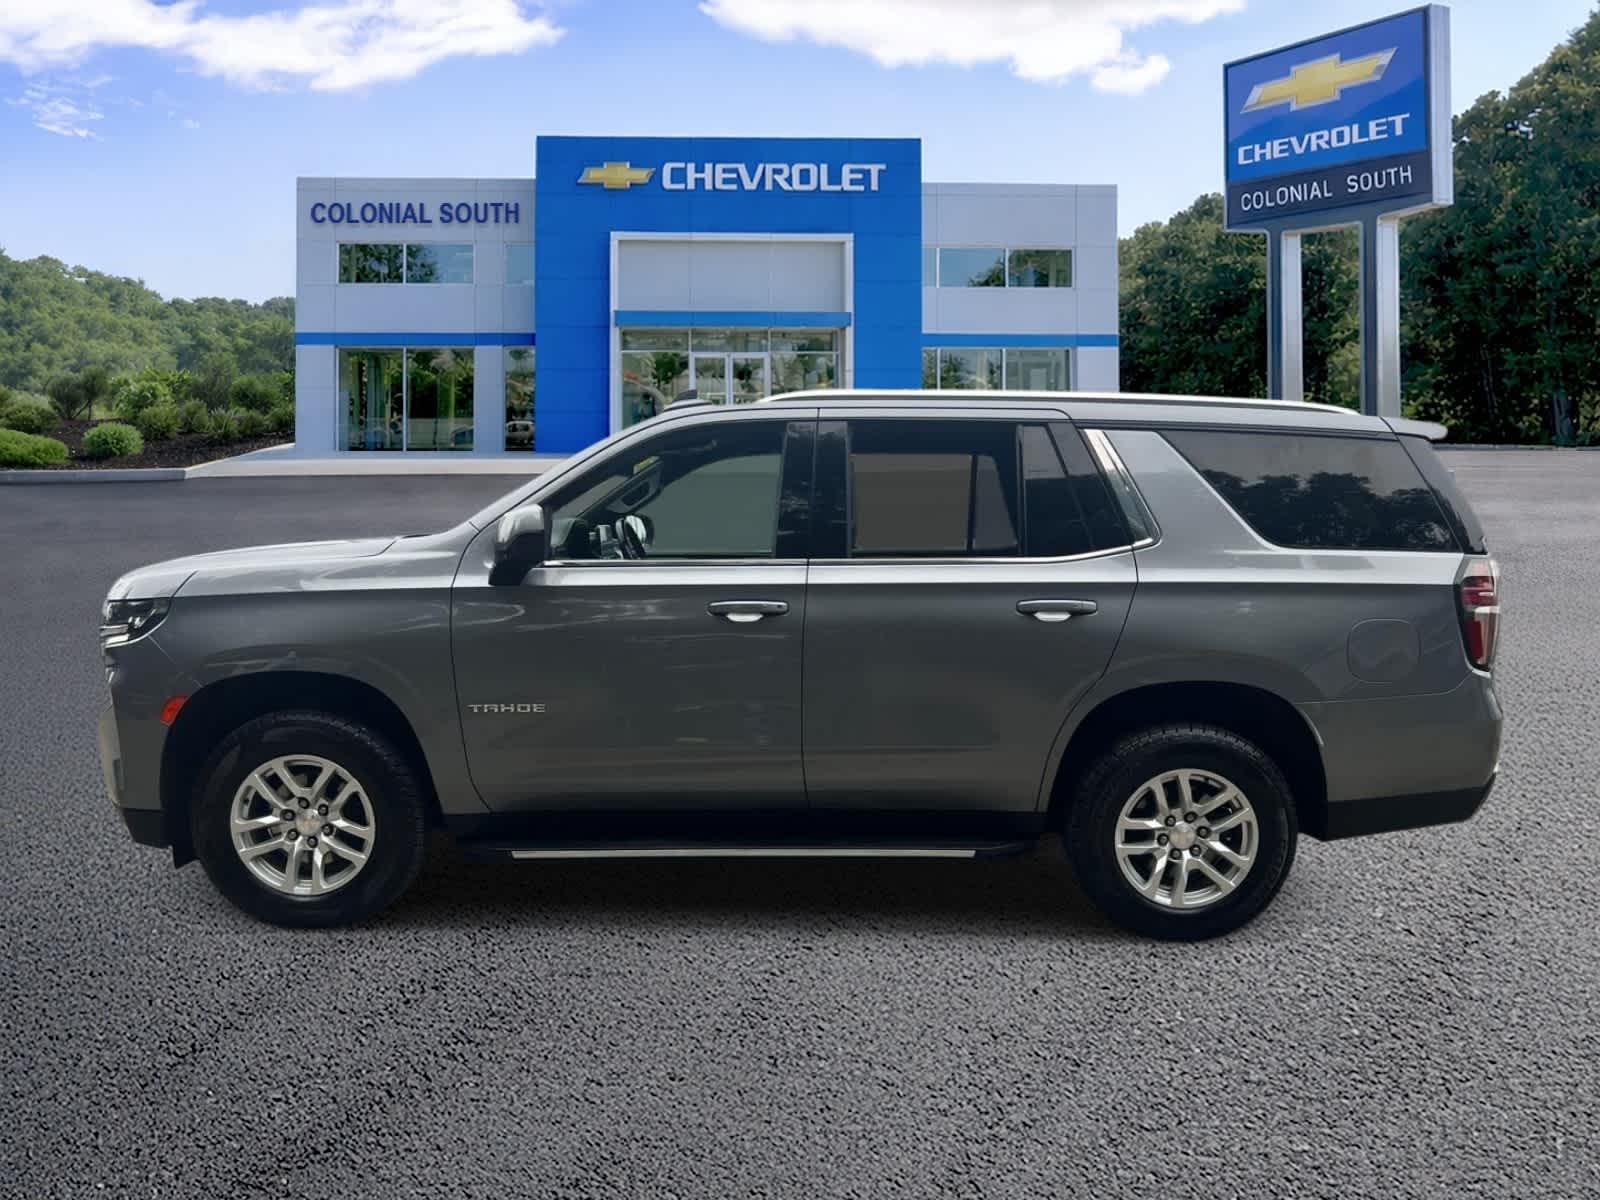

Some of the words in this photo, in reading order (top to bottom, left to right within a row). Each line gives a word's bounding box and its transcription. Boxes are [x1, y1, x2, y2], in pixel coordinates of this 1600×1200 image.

[1237, 113, 1410, 165] CHEVROLET
[661, 161, 887, 192] CHEVROLET
[1240, 180, 1333, 211] COLONIAL
[1346, 165, 1412, 193] SOUTH
[310, 202, 433, 224] COLONIAL
[439, 202, 520, 224] SOUTH
[467, 703, 546, 713] TAHOE
